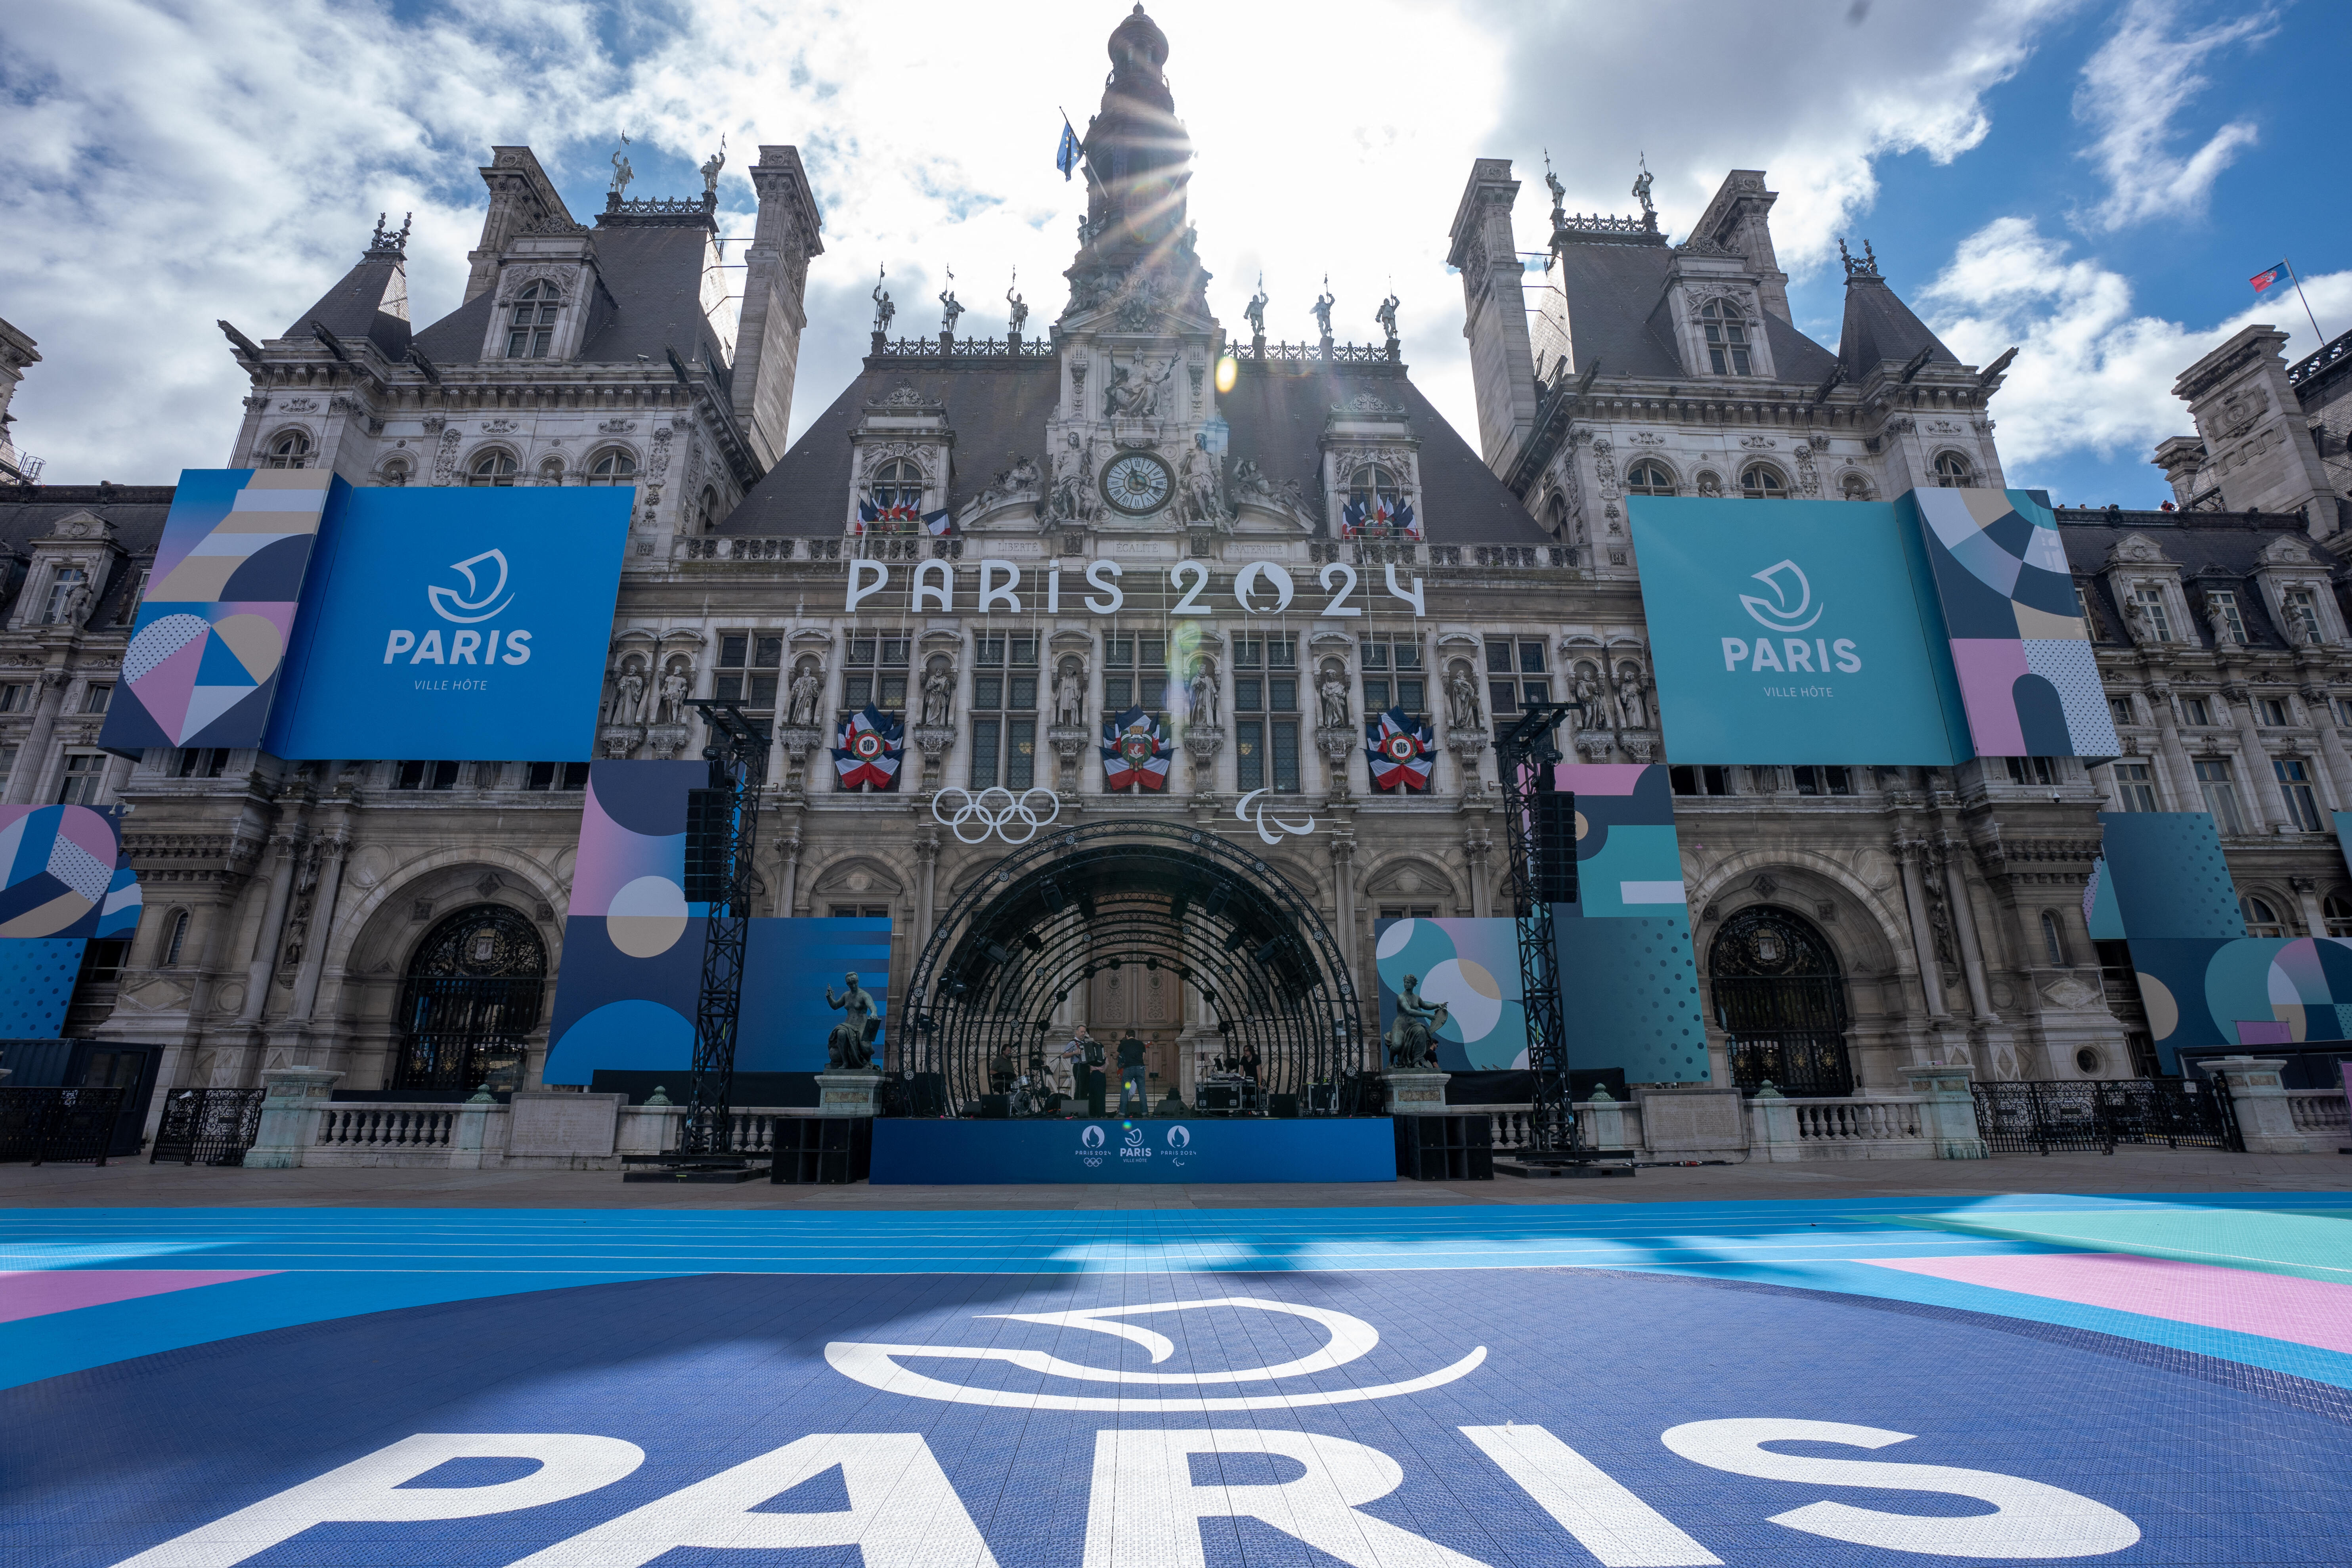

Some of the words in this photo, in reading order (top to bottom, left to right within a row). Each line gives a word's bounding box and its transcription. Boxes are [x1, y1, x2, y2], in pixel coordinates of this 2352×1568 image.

[998, 542, 1038, 551] LIBERTÉ
[1116, 543, 1158, 552] ÉGALITÉ
[1229, 544, 1283, 554] FRATERNITÉ
[845, 558, 1123, 614] PARIS
[383, 629, 532, 665] PARIS
[1721, 637, 1861, 673] PARIS
[415, 680, 448, 690] VILLE
[453, 679, 488, 690] HÔTE
[1763, 687, 1797, 697] VILLE
[1801, 686, 1834, 697] HÔTE
[862, 740, 875, 751] RF
[1395, 742, 1407, 754] RF
[1120, 1148, 1151, 1157] PARIS
[107, 1418, 2142, 1568] PARIS
